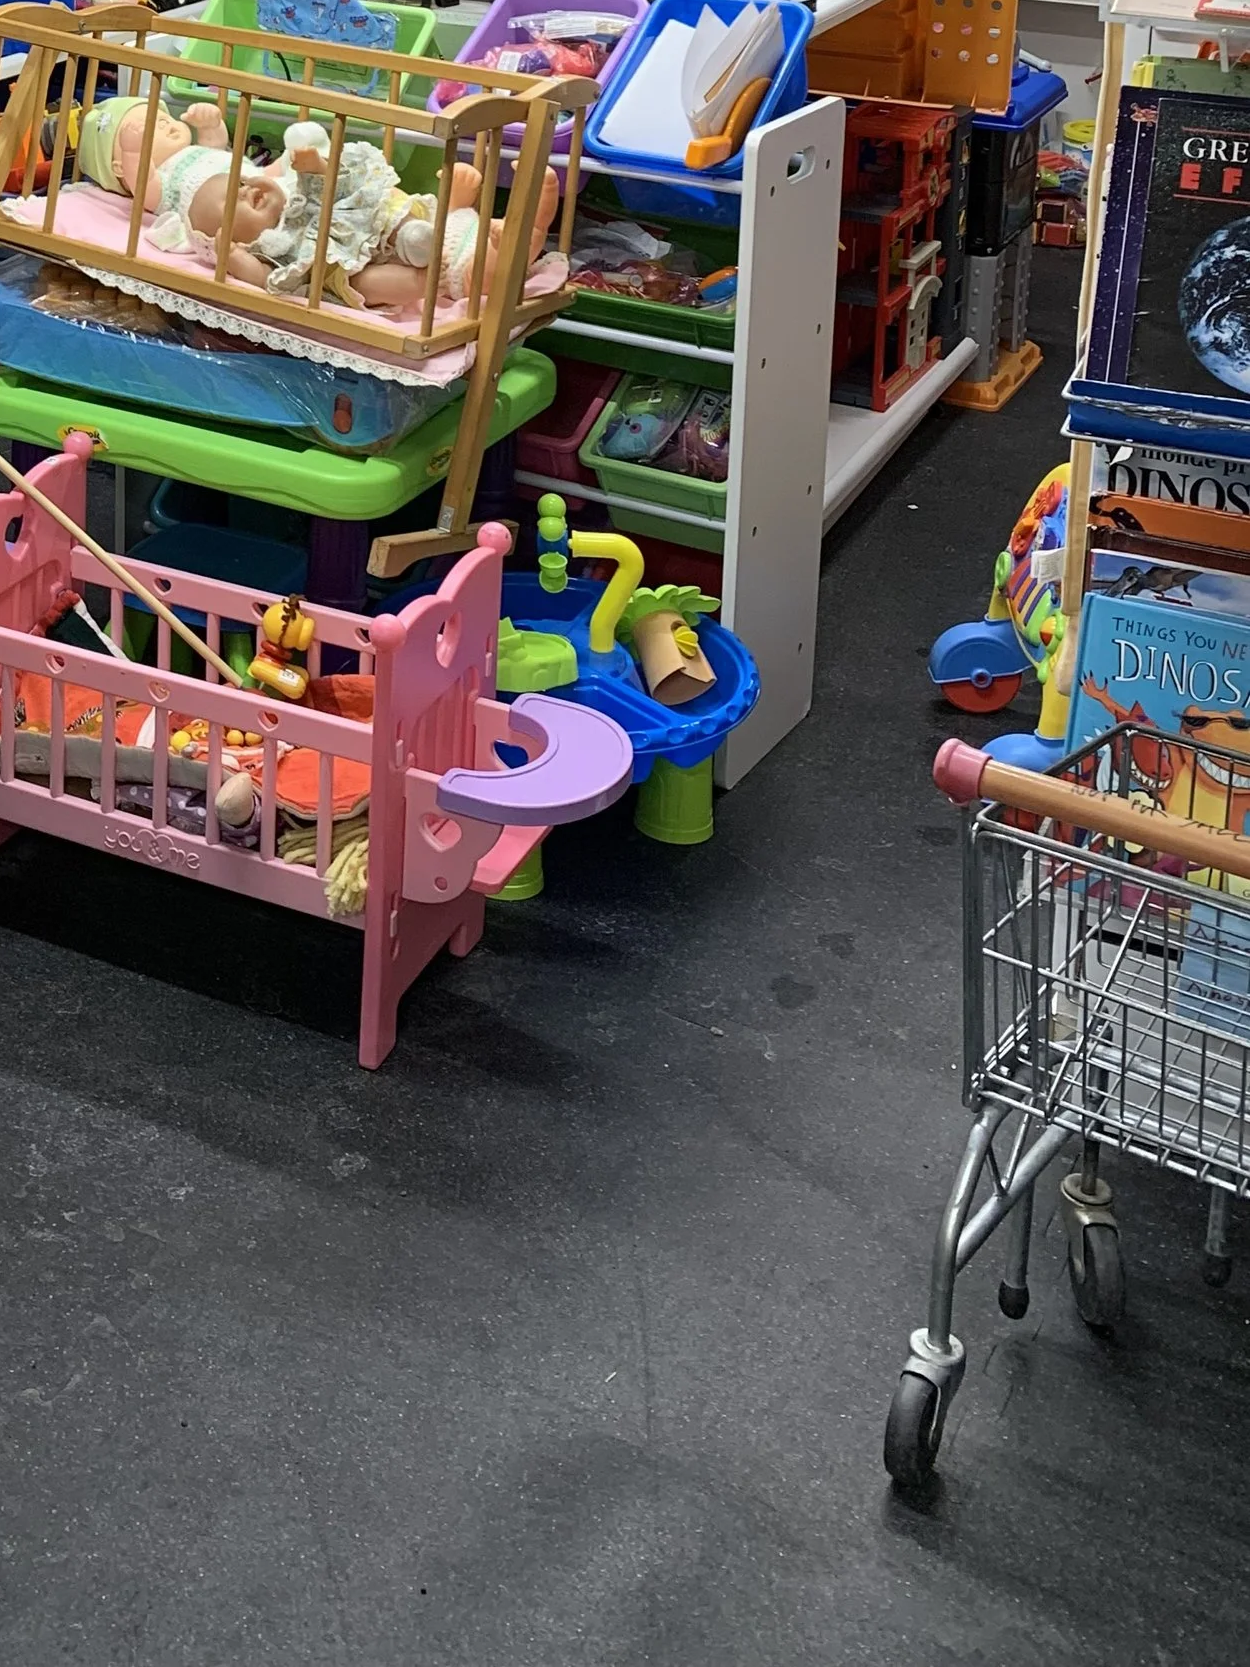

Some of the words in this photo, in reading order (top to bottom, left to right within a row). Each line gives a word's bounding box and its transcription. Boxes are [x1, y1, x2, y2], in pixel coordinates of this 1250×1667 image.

[1182, 136, 1250, 164] GRE
[1112, 617, 1177, 643] THINGS
[1184, 630, 1217, 650] YOU
[104, 825, 142, 852] you
[169, 846, 201, 870] me
